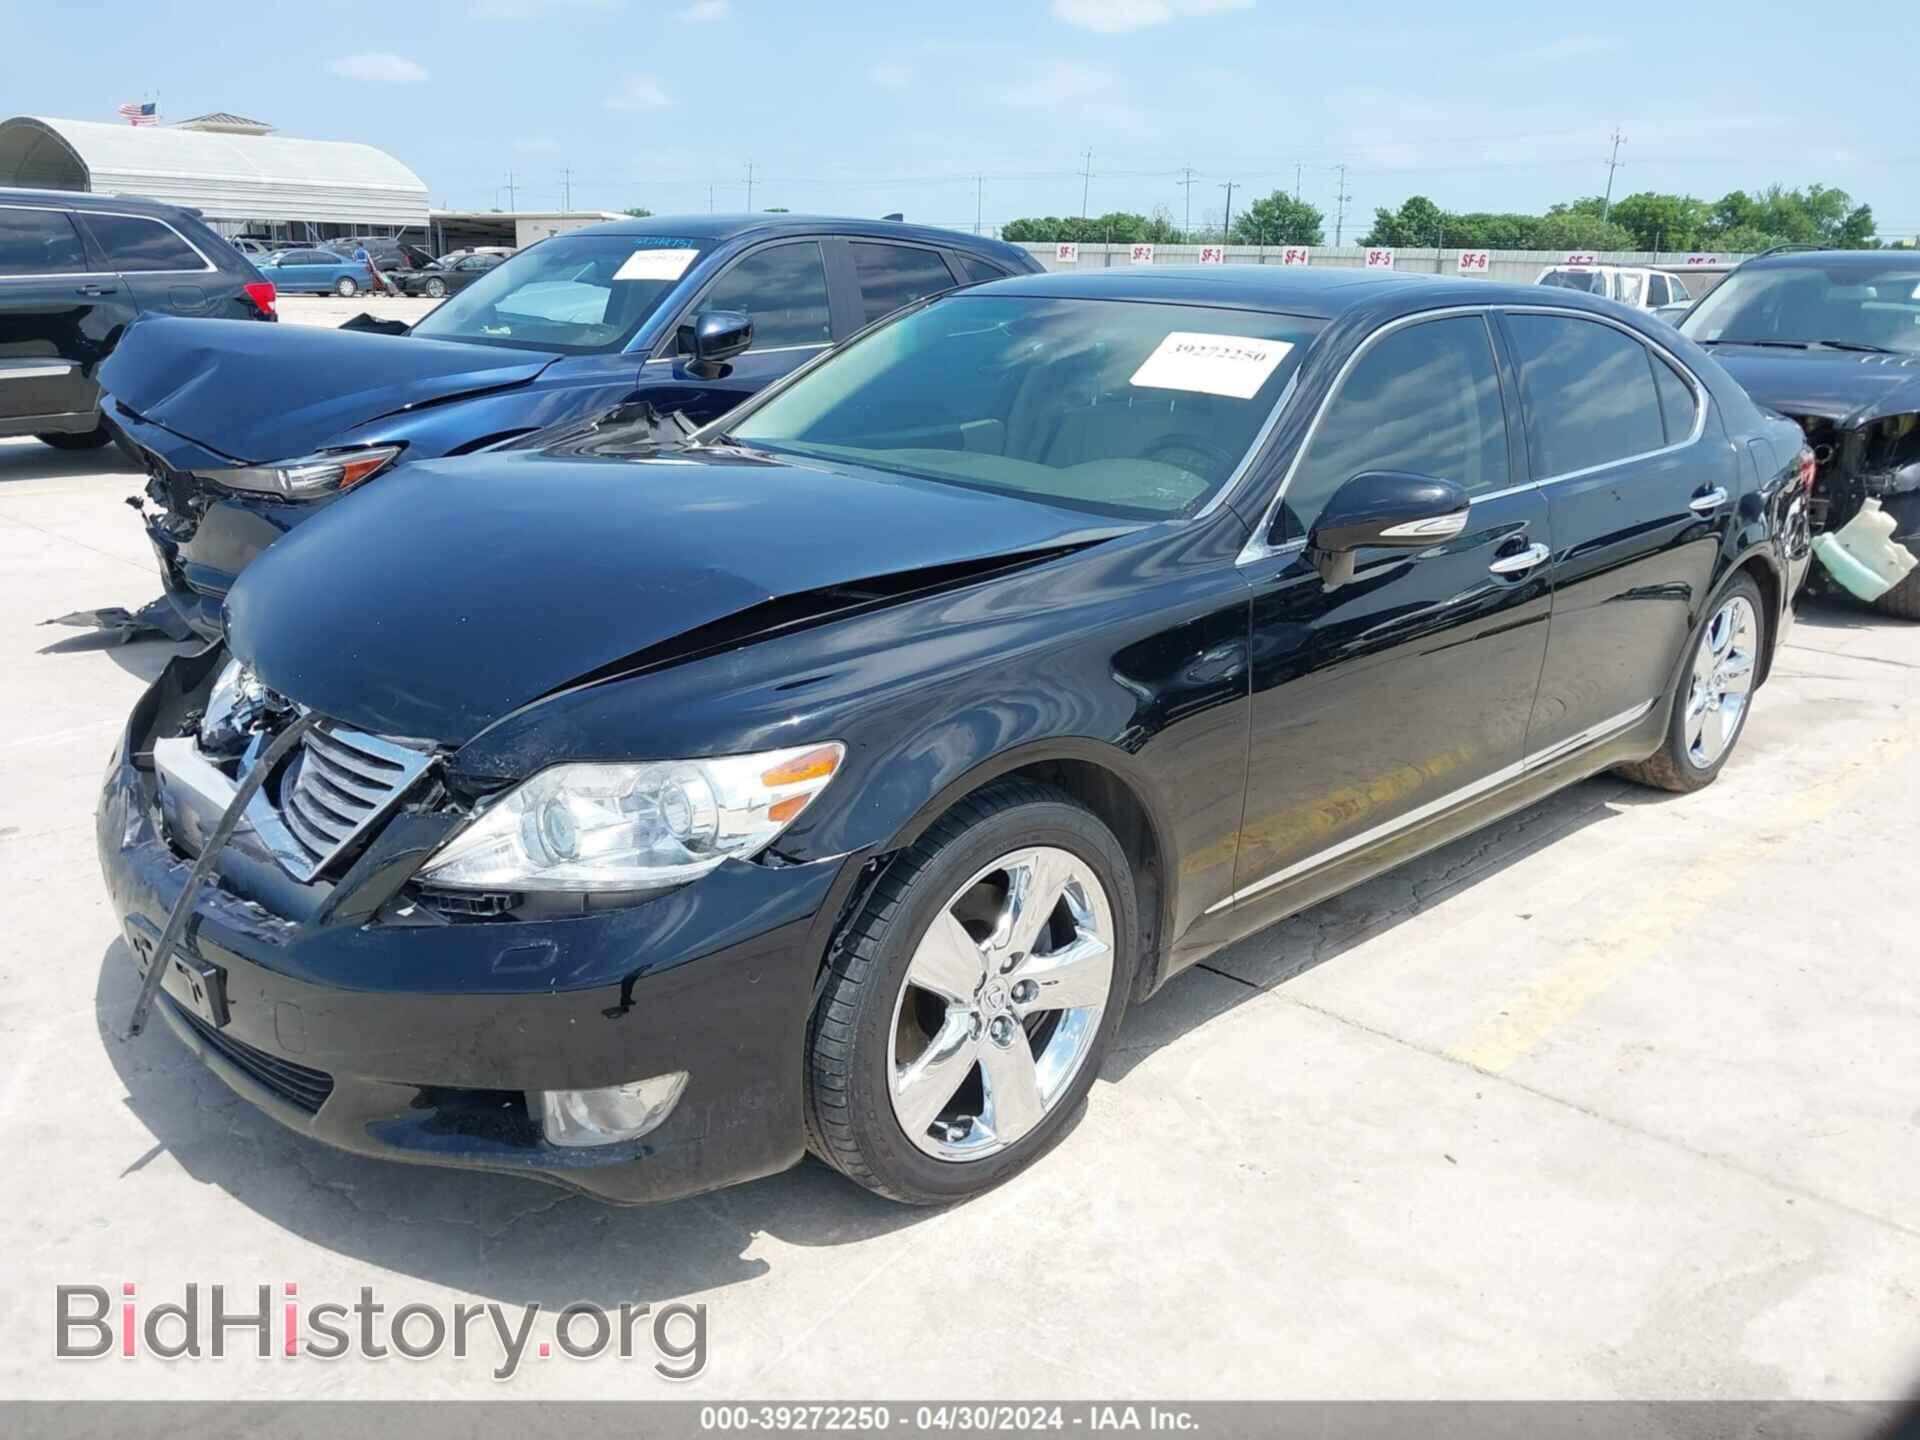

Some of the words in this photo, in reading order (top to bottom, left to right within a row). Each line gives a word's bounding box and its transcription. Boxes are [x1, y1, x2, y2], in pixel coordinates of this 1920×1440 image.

[1060, 246, 1075, 258] SF-1
[1133, 247, 1152, 259] SF-2
[1201, 248, 1221, 262] SF-3
[1284, 249, 1306, 264] SF-4
[1368, 251, 1391, 266] SF-5
[1461, 254, 1486, 268] SF-6
